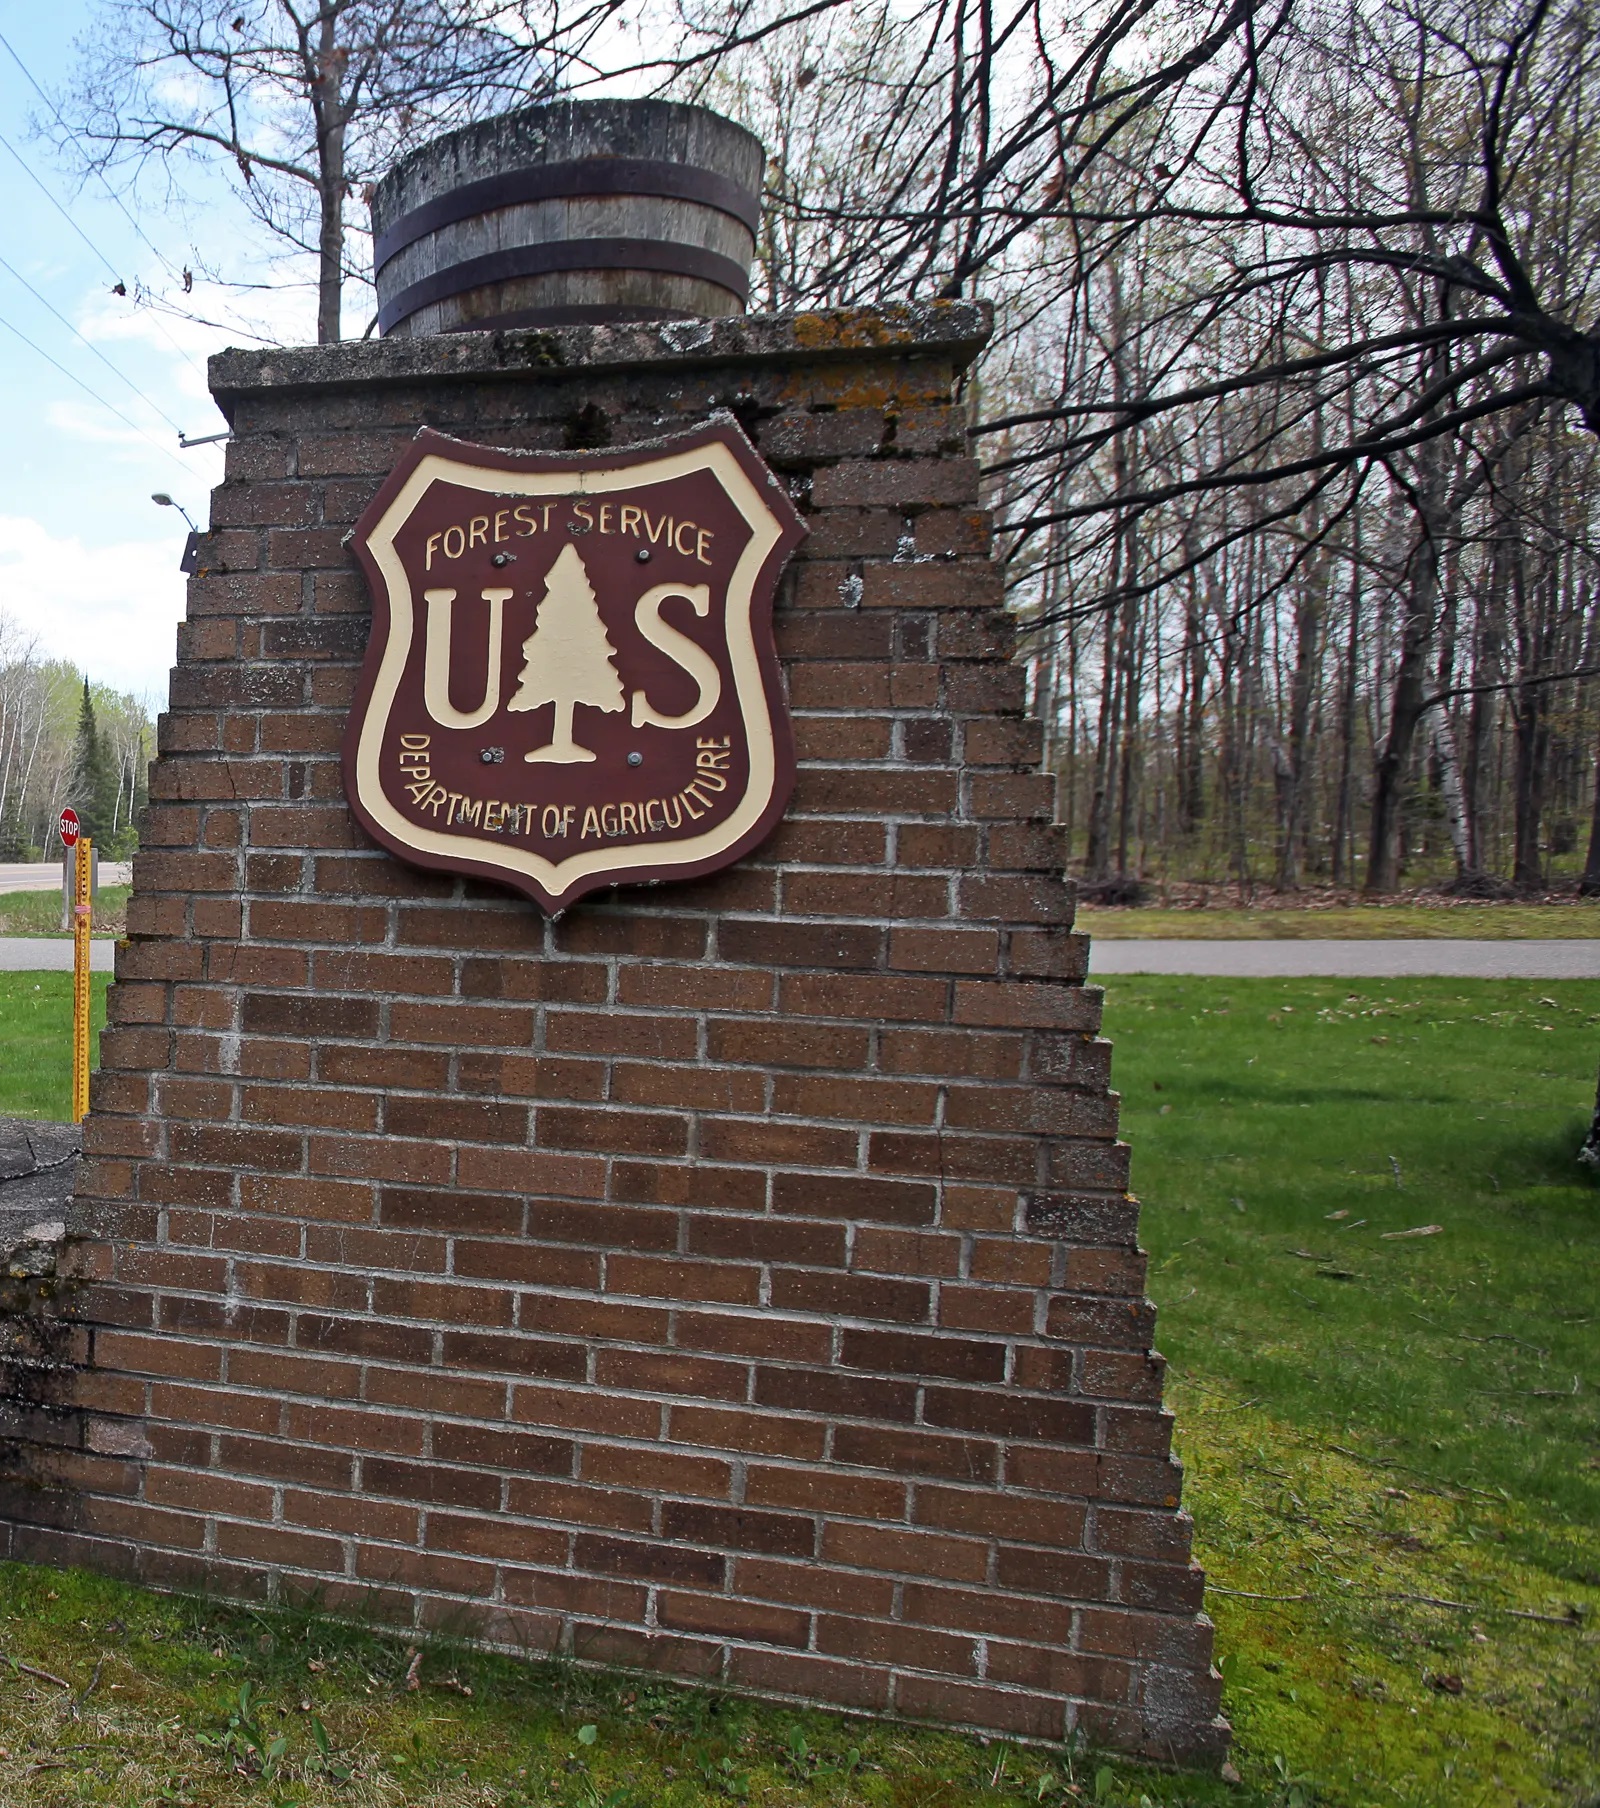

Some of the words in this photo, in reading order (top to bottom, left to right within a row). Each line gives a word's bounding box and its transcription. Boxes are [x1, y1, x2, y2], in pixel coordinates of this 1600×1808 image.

[424, 504, 557, 571] FOREST
[570, 501, 715, 566] SERVICE
[399, 733, 538, 836] DEPARTMENT
[541, 803, 576, 839] OF
[580, 734, 731, 840] AGRICULTURE
[60, 818, 78, 836] STOP
